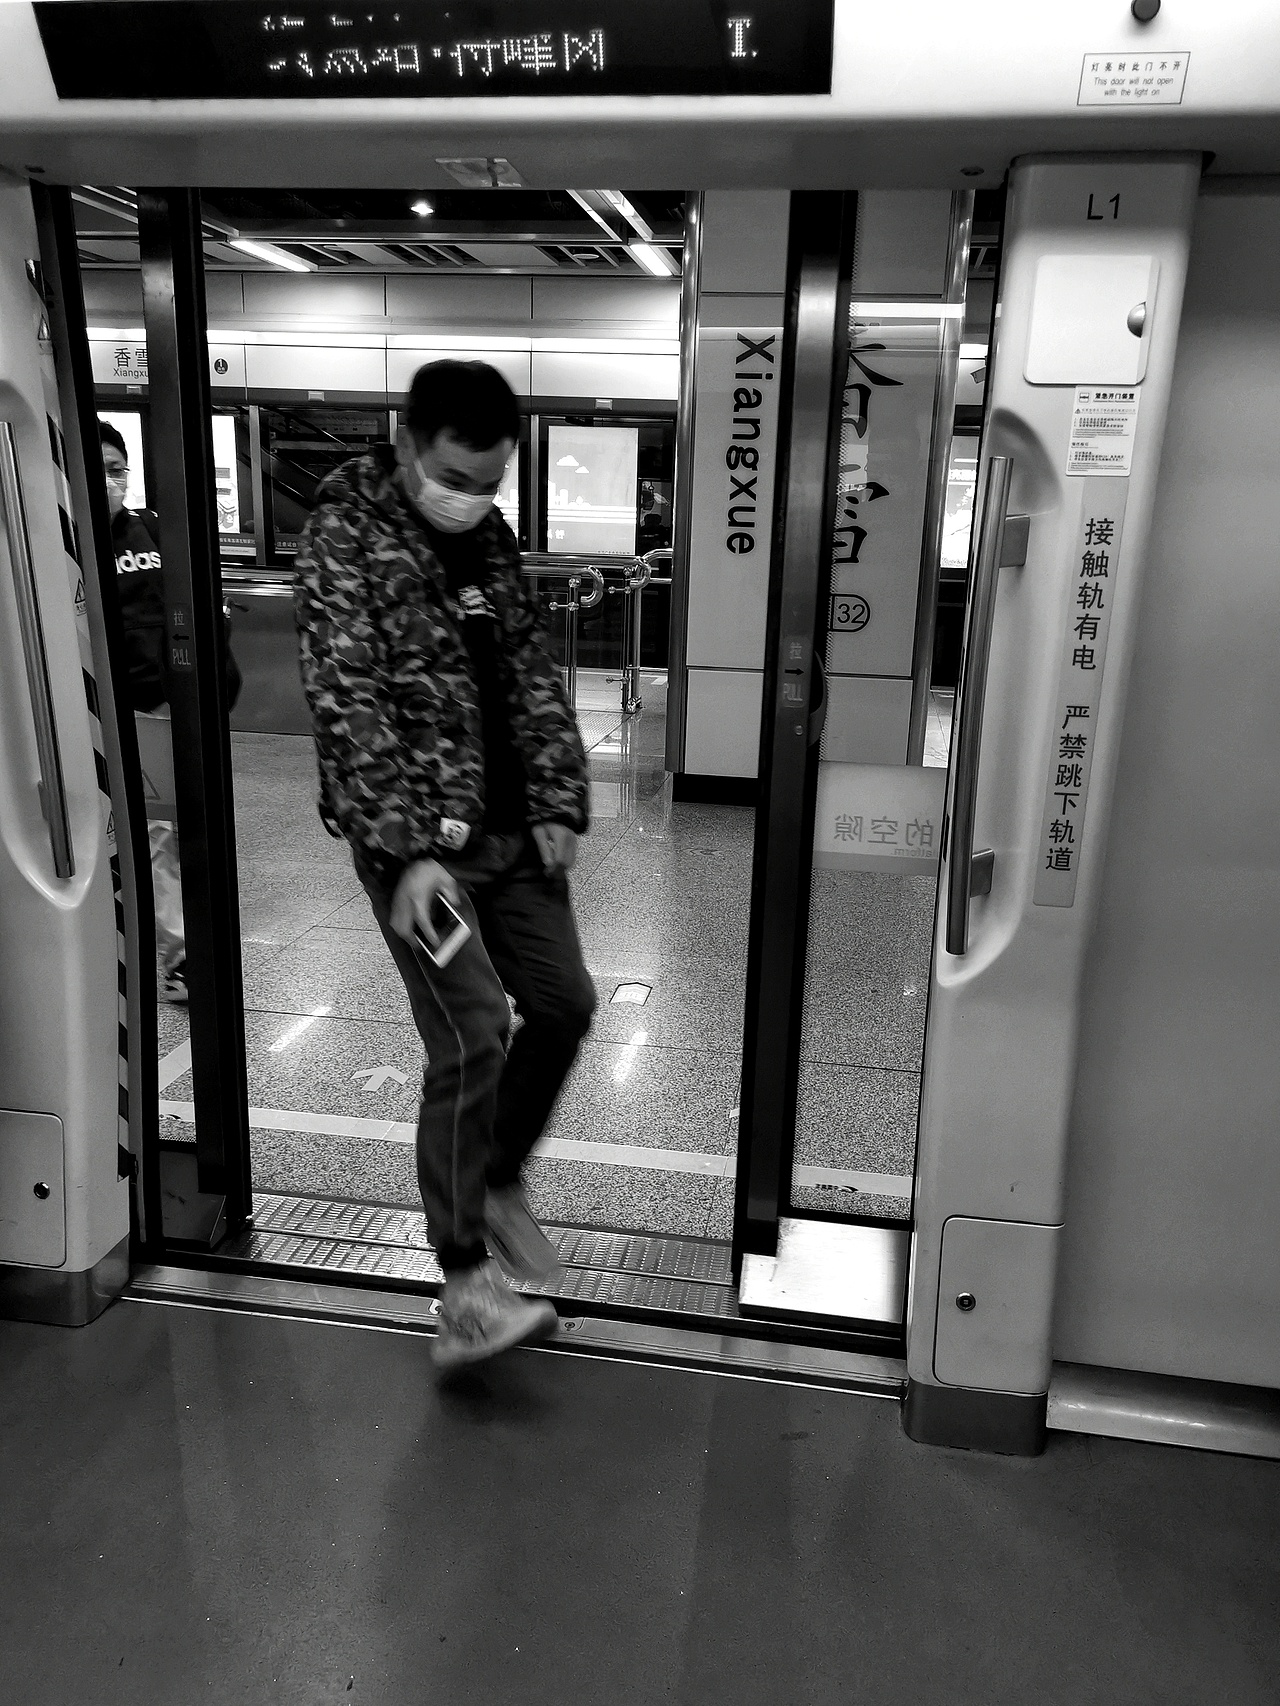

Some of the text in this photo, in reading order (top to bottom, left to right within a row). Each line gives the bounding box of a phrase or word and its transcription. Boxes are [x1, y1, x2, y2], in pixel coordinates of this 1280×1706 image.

[1091, 60, 1181, 72] 灯亮时此门不开
[1094, 77, 1174, 87] This door will not open
[1104, 88, 1117, 96] with
[1120, 88, 1131, 96] the
[1134, 88, 1149, 97] light
[1087, 193, 1120, 220] L1
[114, 347, 148, 367] 香雪
[113, 367, 149, 379] Xiangxu
[726, 332, 776, 555] Xiangxue
[114, 549, 162, 575] idas
[1072, 518, 1115, 670] 接触轨有电
[172, 648, 191, 665] PULL
[1045, 705, 1090, 871] 严禁跳下轨道
